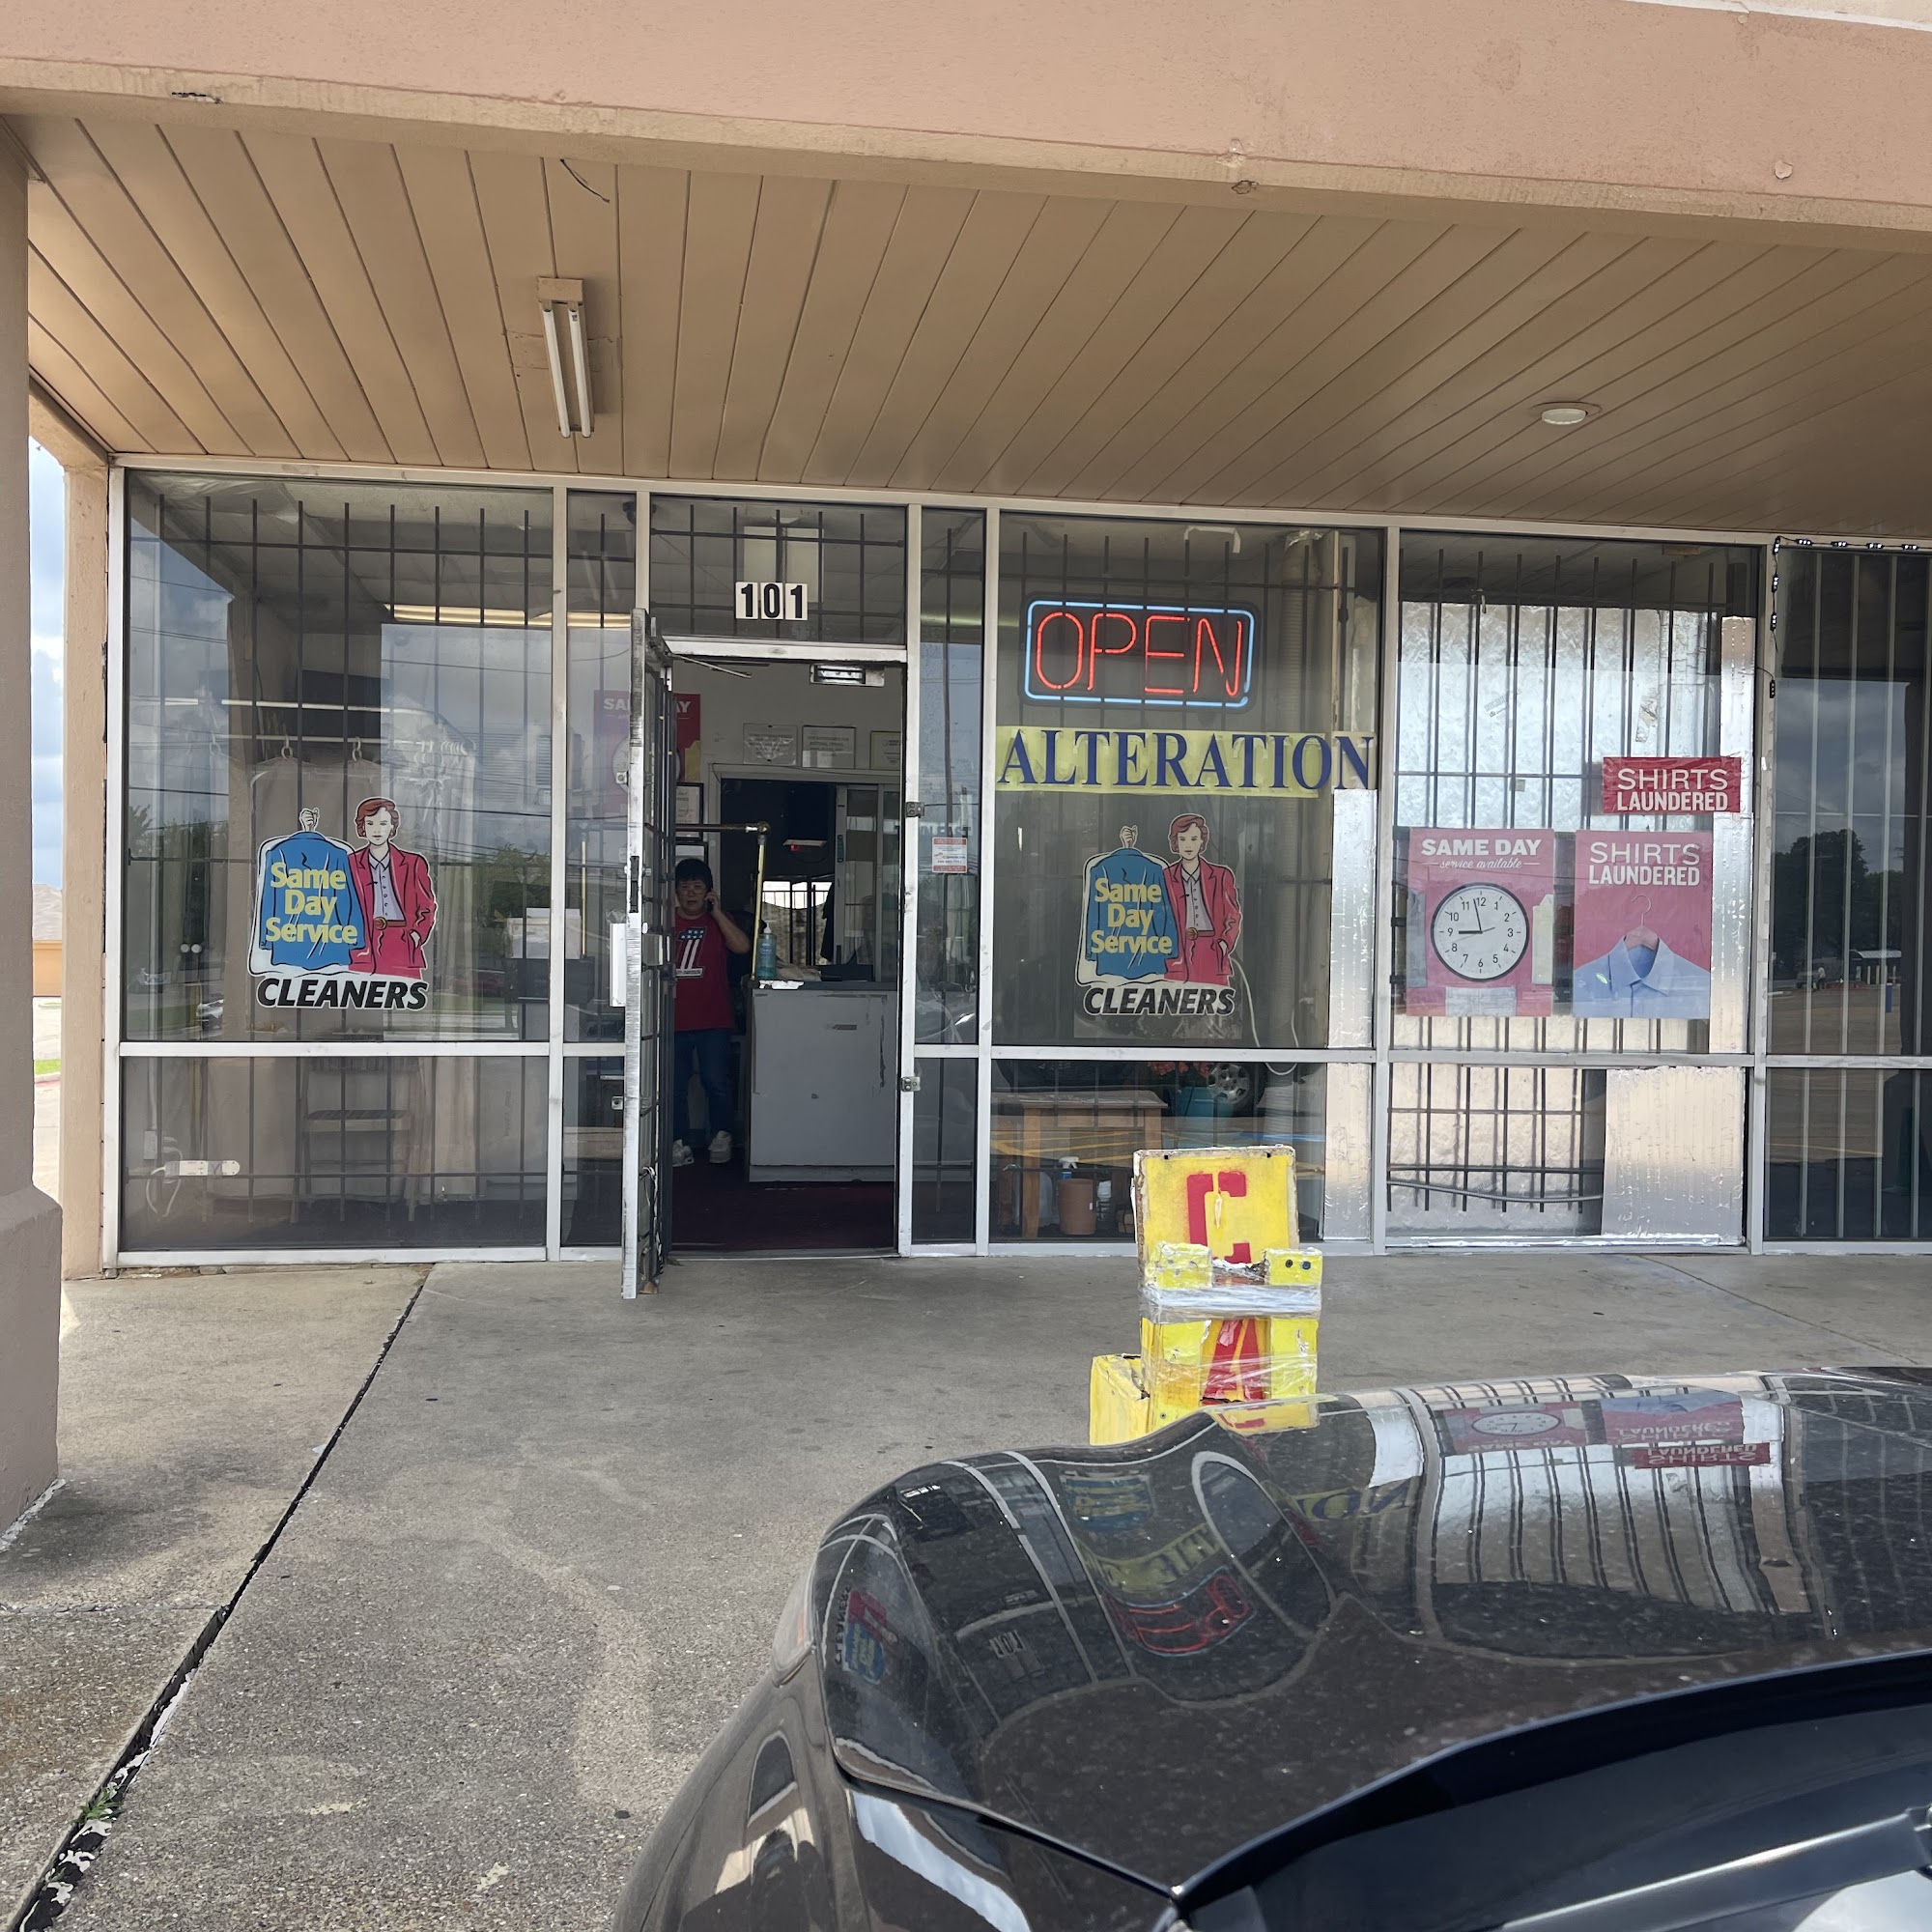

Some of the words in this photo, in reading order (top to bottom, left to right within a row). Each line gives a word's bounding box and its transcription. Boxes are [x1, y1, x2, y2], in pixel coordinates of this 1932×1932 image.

[741, 582, 803, 618] 101
[1036, 611, 1242, 696] OPEN
[998, 729, 1376, 790] ALTERATION
[1617, 768, 1728, 790] SHIRTS
[1617, 791, 1728, 811] LAUNDERED
[1421, 838, 1489, 856] SAME
[1494, 838, 1542, 856] DAY
[1590, 842, 1700, 866] SHIRTS
[1440, 859, 1474, 868] service
[1477, 857, 1522, 868] available
[270, 862, 346, 891] Same
[1589, 866, 1700, 886] LAUNDERED
[1094, 877, 1161, 903] Same
[1476, 897, 1486, 906] 12
[285, 891, 336, 923] Day
[1108, 902, 1153, 932] Day
[1462, 901, 1469, 910] 11
[1504, 913, 1509, 922] 2
[266, 919, 357, 944] Service
[1091, 930, 1173, 954] Service
[1508, 928, 1513, 937] 3
[1452, 943, 1457, 952] 8
[1493, 954, 1498, 963] 5
[1478, 958, 1483, 967] 6
[258, 979, 427, 1009] CLEANERS
[1084, 986, 1235, 1016] CLEANERS
